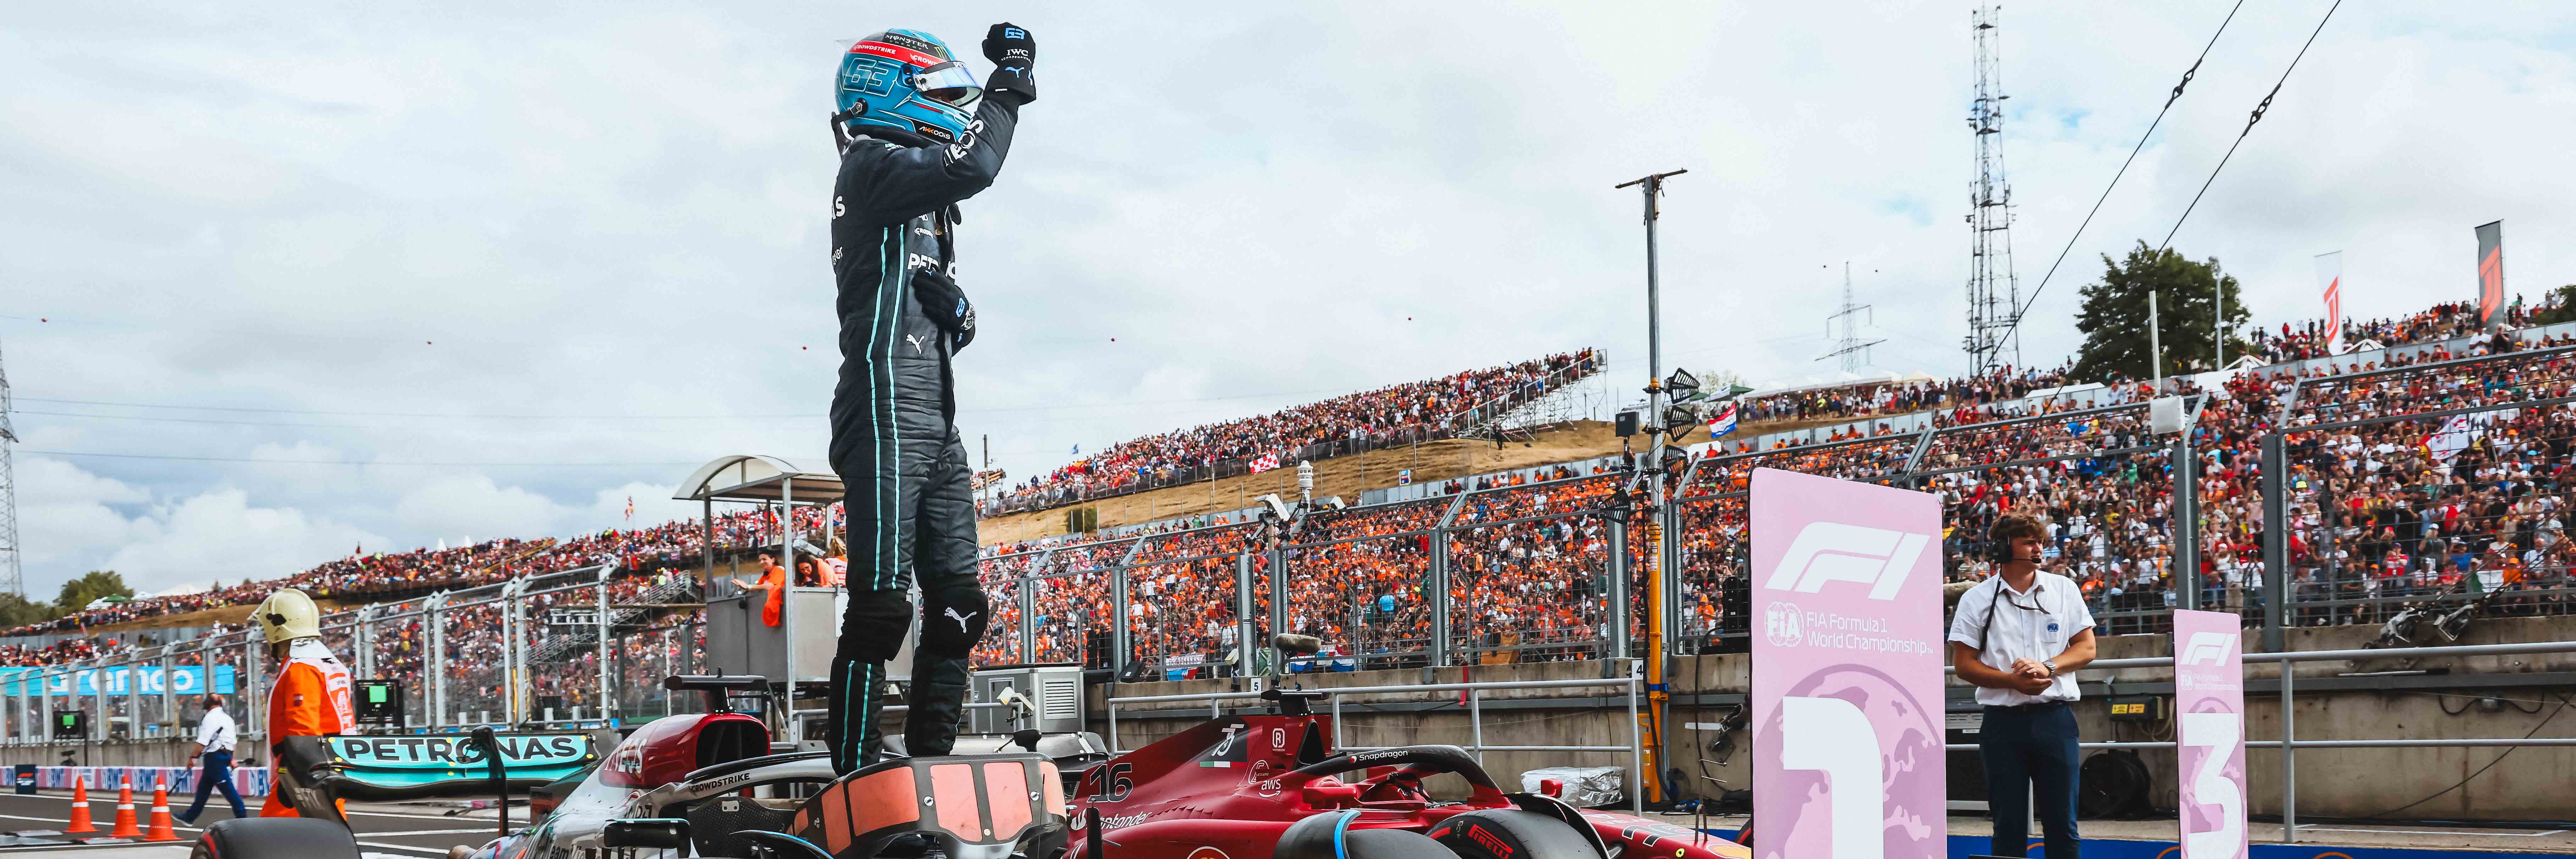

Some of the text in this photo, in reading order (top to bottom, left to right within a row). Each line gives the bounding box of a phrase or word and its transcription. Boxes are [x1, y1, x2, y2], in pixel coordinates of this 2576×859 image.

[843, 58, 901, 97] 63
[1764, 521, 1931, 601] F1
[1806, 611, 1888, 633] FIA Formula 1
[1807, 630, 1844, 649] World
[2179, 631, 2238, 667] F1
[1636, 664, 1643, 675] 4
[1254, 682, 1258, 691] 5
[344, 737, 577, 764] PETRONAS
[1359, 750, 1408, 761] Snapdragon
[692, 772, 750, 793] CROWDSTRIKE
[1086, 762, 1133, 803] 16
[1261, 779, 1281, 790] aws
[1783, 696, 1885, 859] 1
[2183, 712, 2242, 859] 3
